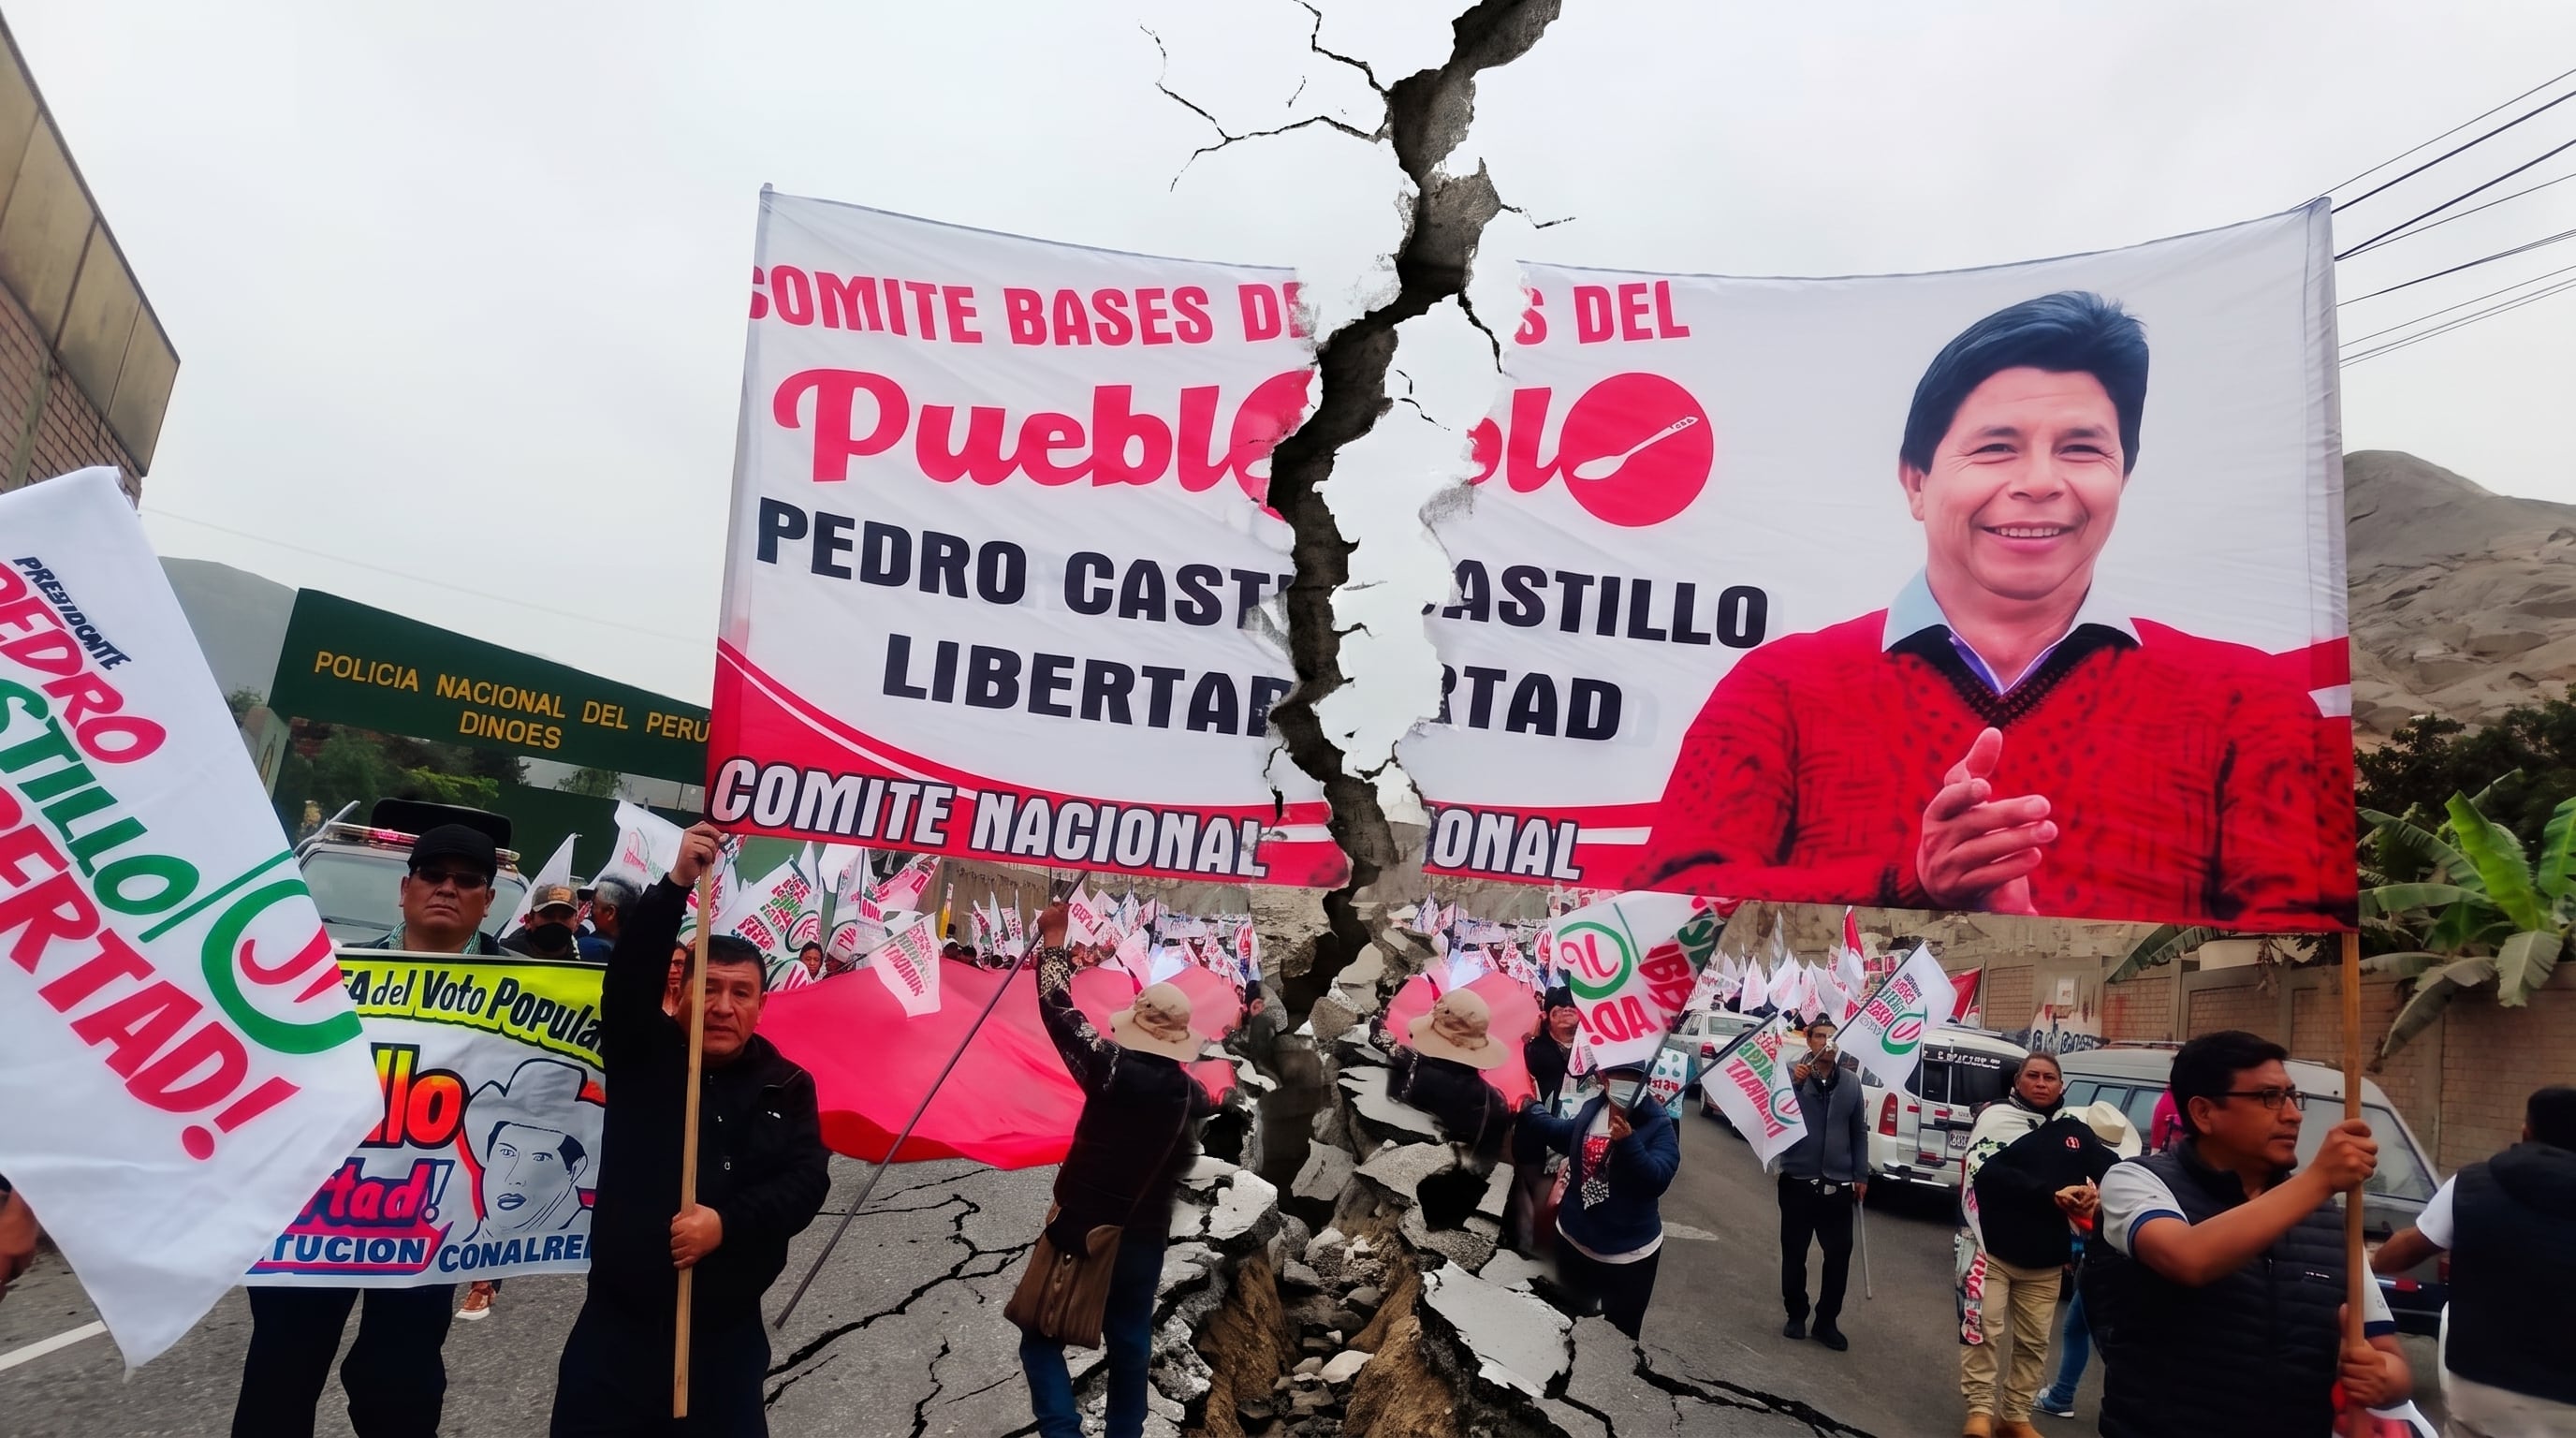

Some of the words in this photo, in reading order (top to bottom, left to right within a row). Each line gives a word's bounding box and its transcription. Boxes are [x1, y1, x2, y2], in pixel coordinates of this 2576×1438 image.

[1003, 286, 1213, 346] BASES
[1573, 280, 1690, 344] DEL
[756, 496, 1027, 605] PEDRO
[1063, 551, 1296, 630] CAST
[1421, 559, 1768, 649] ASTILLO
[315, 651, 419, 692] POLICIA
[435, 673, 566, 719] NACIONAL
[581, 700, 629, 730] DEL
[646, 712, 711, 742] PERU
[460, 711, 563, 750] DINOES
[710, 756, 956, 845] COMITE
[969, 788, 1270, 878] NACIONAL
[1426, 807, 1583, 882] ONAL
[371, 969, 417, 1006] del
[420, 970, 487, 1016] Voto
[486, 977, 601, 1054] Popula
[438, 1234, 591, 1273] CONALRE
